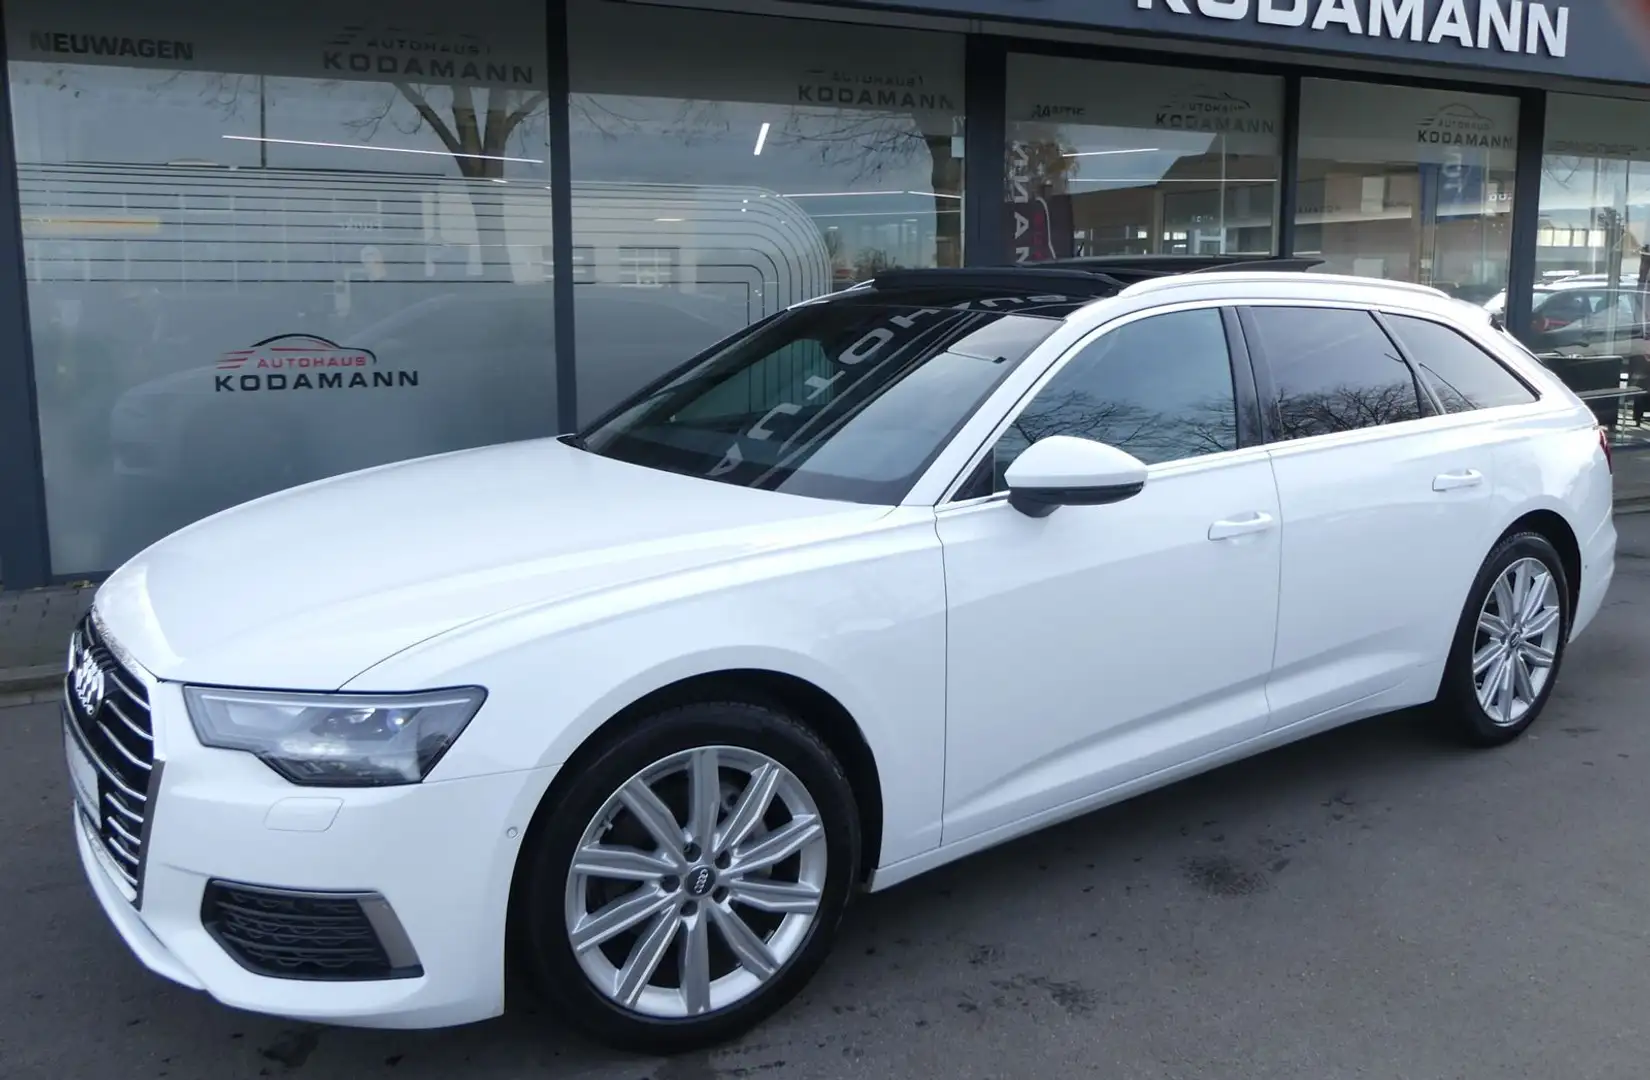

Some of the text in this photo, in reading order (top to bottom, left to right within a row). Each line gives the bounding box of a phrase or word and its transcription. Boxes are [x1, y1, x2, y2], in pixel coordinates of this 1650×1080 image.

[29, 30, 194, 61] NEUWAGEN
[323, 51, 533, 84] KODAMANN
[798, 85, 956, 110] KODAMANN
[1156, 113, 1274, 133] KODAMANN
[1418, 130, 1512, 149] KODAMANN
[257, 356, 367, 369] AUTOHAUS
[215, 370, 419, 392] KODAMANN
